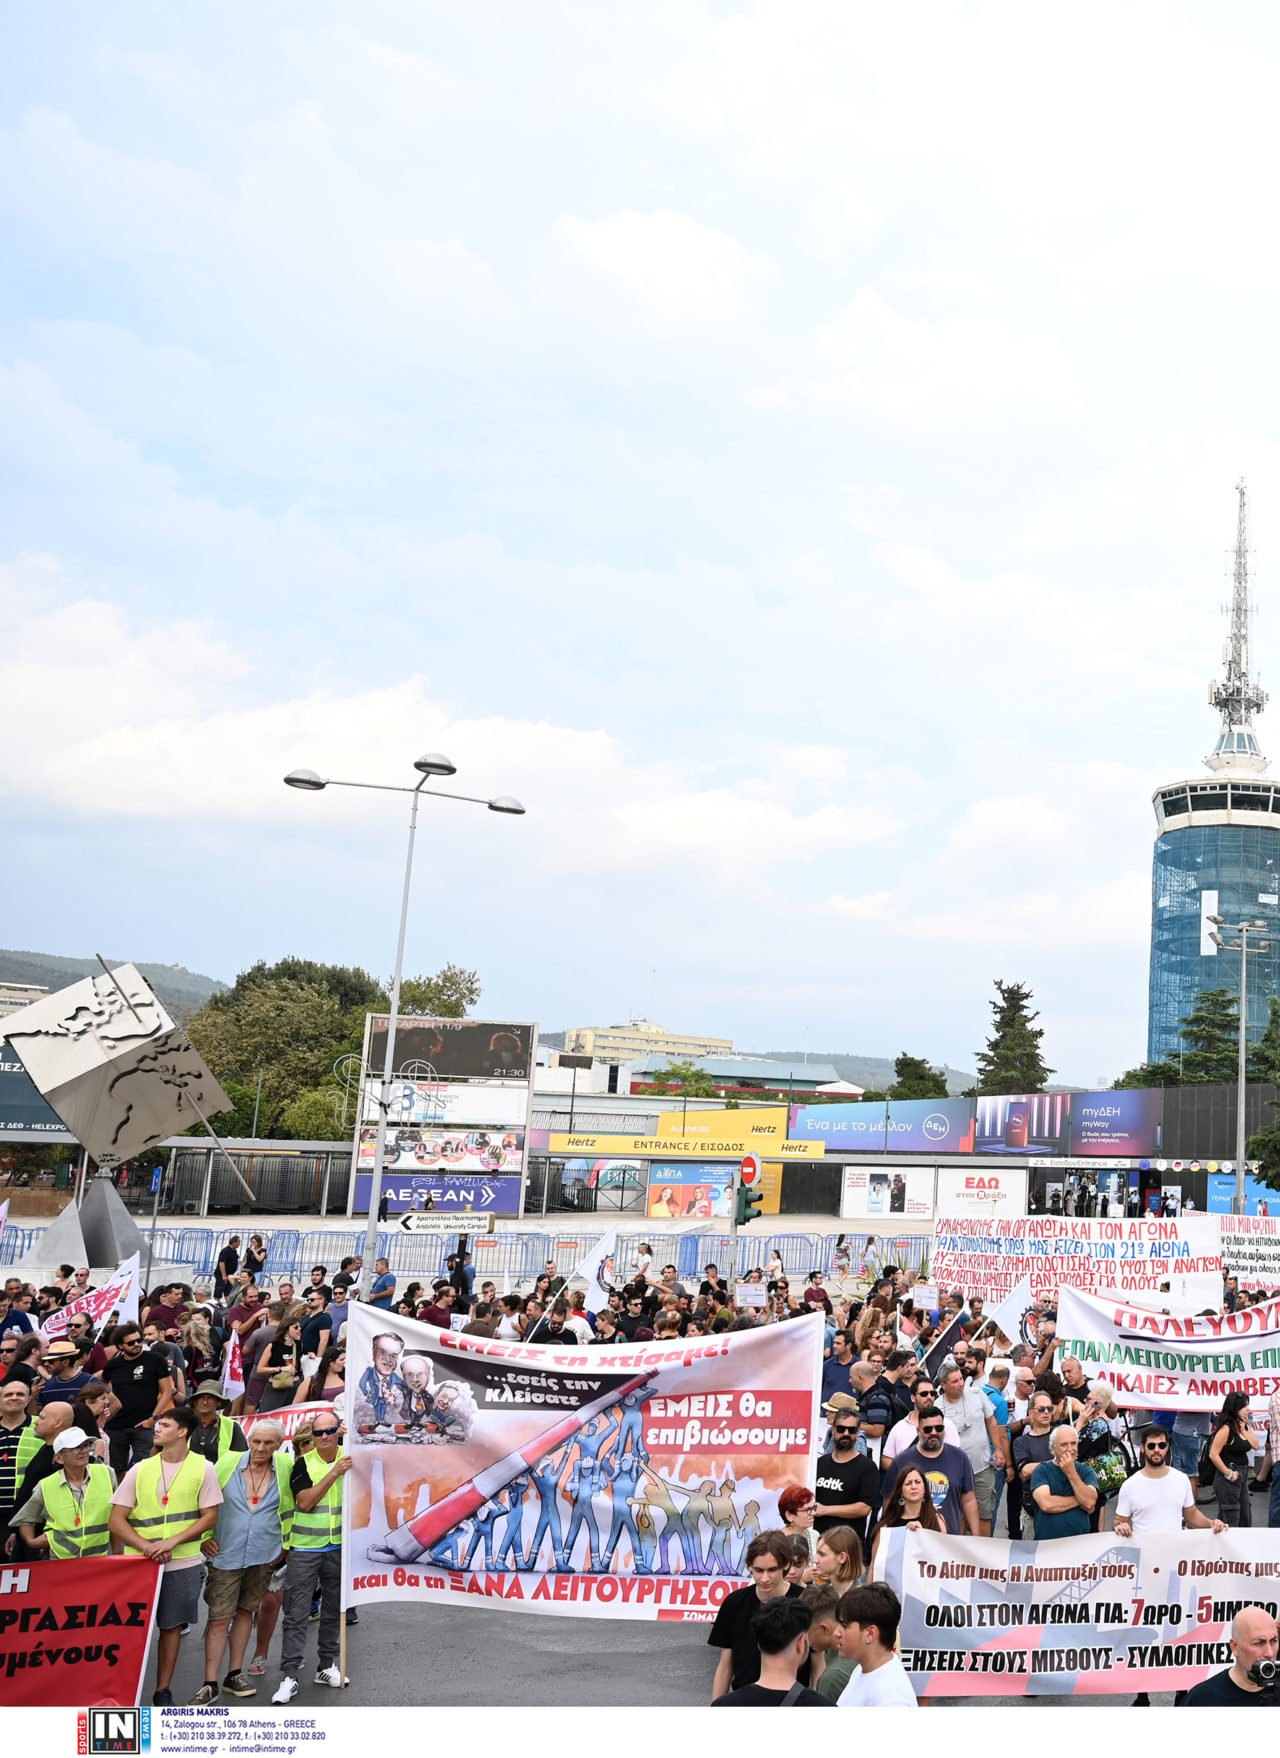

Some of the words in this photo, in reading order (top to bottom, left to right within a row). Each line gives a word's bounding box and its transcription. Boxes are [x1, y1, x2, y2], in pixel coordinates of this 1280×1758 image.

[376, 1018, 435, 1029] ΤΕΑΡΤΗ
[494, 1068, 525, 1077] 21:30
[1082, 1107, 1121, 1118] myΔΕΗ
[751, 1125, 777, 1134] Hertz
[806, 1118, 830, 1131] Ένα
[833, 1121, 848, 1133] με
[851, 1121, 866, 1131] το
[869, 1119, 913, 1133] μέλλον
[926, 1121, 946, 1133] ΔΕΗ
[567, 1137, 597, 1148] Hertz
[633, 1140, 690, 1151] ENTRANCE
[700, 1142, 745, 1151] ΕΙΣΟΔΟΣ
[781, 1143, 808, 1153] Hertz
[965, 1177, 1000, 1189] ΕΔΩ
[996, 1219, 1012, 1237] ΤΗΝ
[1013, 1219, 1068, 1238] ΟΡΓΑΝΩΣΗ
[1071, 1222, 1091, 1240] ΚΑΙ
[1097, 1222, 1123, 1240] ΤΟΝ
[1128, 1222, 1179, 1241] ΑΓΩΝΑ
[1087, 1242, 1115, 1259] ΣΤΟΝ
[1149, 1241, 1190, 1258] ΑΙΩΝΑ
[1096, 1259, 1116, 1274] ΣΤΟ
[1120, 1259, 1147, 1275] ΥΨΟΣ
[1150, 1258, 1169, 1275] ΤΩΝ
[1173, 1256, 1223, 1274] ΑΝΑΓΚΩΝ
[1099, 1275, 1117, 1289] ΓΙΑ
[1121, 1276, 1159, 1290] ΟΛΟΥΣ
[440, 1331, 547, 1361] ΕΜΕΙΣ
[552, 1355, 589, 1367] τη
[1057, 1338, 1246, 1374] ΕΠΑΝΑΛΕΙΤΟΥΡΓΕΙΑ
[563, 1379, 602, 1391] την
[649, 1394, 734, 1418] ΕΜΕΙΣ
[738, 1392, 772, 1418] θα
[646, 1419, 807, 1452] επιβιώσουμε
[918, 1560, 937, 1578] Το
[939, 1560, 976, 1580] Αίμα
[979, 1568, 1008, 1582] μας
[1010, 1565, 1022, 1582] Η
[1102, 1562, 1135, 1579] τους
[1177, 1559, 1188, 1577] Ο
[1191, 1556, 1252, 1577] Ιδρώτας
[1255, 1562, 1280, 1577] μας
[353, 1573, 388, 1591] και
[393, 1567, 420, 1588] θα
[423, 1575, 446, 1591] τη
[448, 1570, 524, 1600] ΞΑΝΑ
[531, 1574, 749, 1607] ΛΕΙΤΟΥΡΓΗΣΟΥ
[682, 1611, 718, 1622] ΣΩΜΑΤ
[925, 1604, 973, 1628] ΟΛΟΙ
[977, 1603, 1025, 1627] ΣΤΟΝ
[1027, 1602, 1090, 1625] ΑΓΩΝΑ
[1094, 1602, 1128, 1625] ΓΙΑ:
[1131, 1598, 1182, 1626] 7ΩΡΟ
[968, 1650, 1027, 1673] ΣΤΟΥΣ
[1031, 1648, 1112, 1673] ΜΙΣΘΟΥΣ
[1127, 1642, 1235, 1668] ΣΥΛΛΟΓΙΚΕΣ
